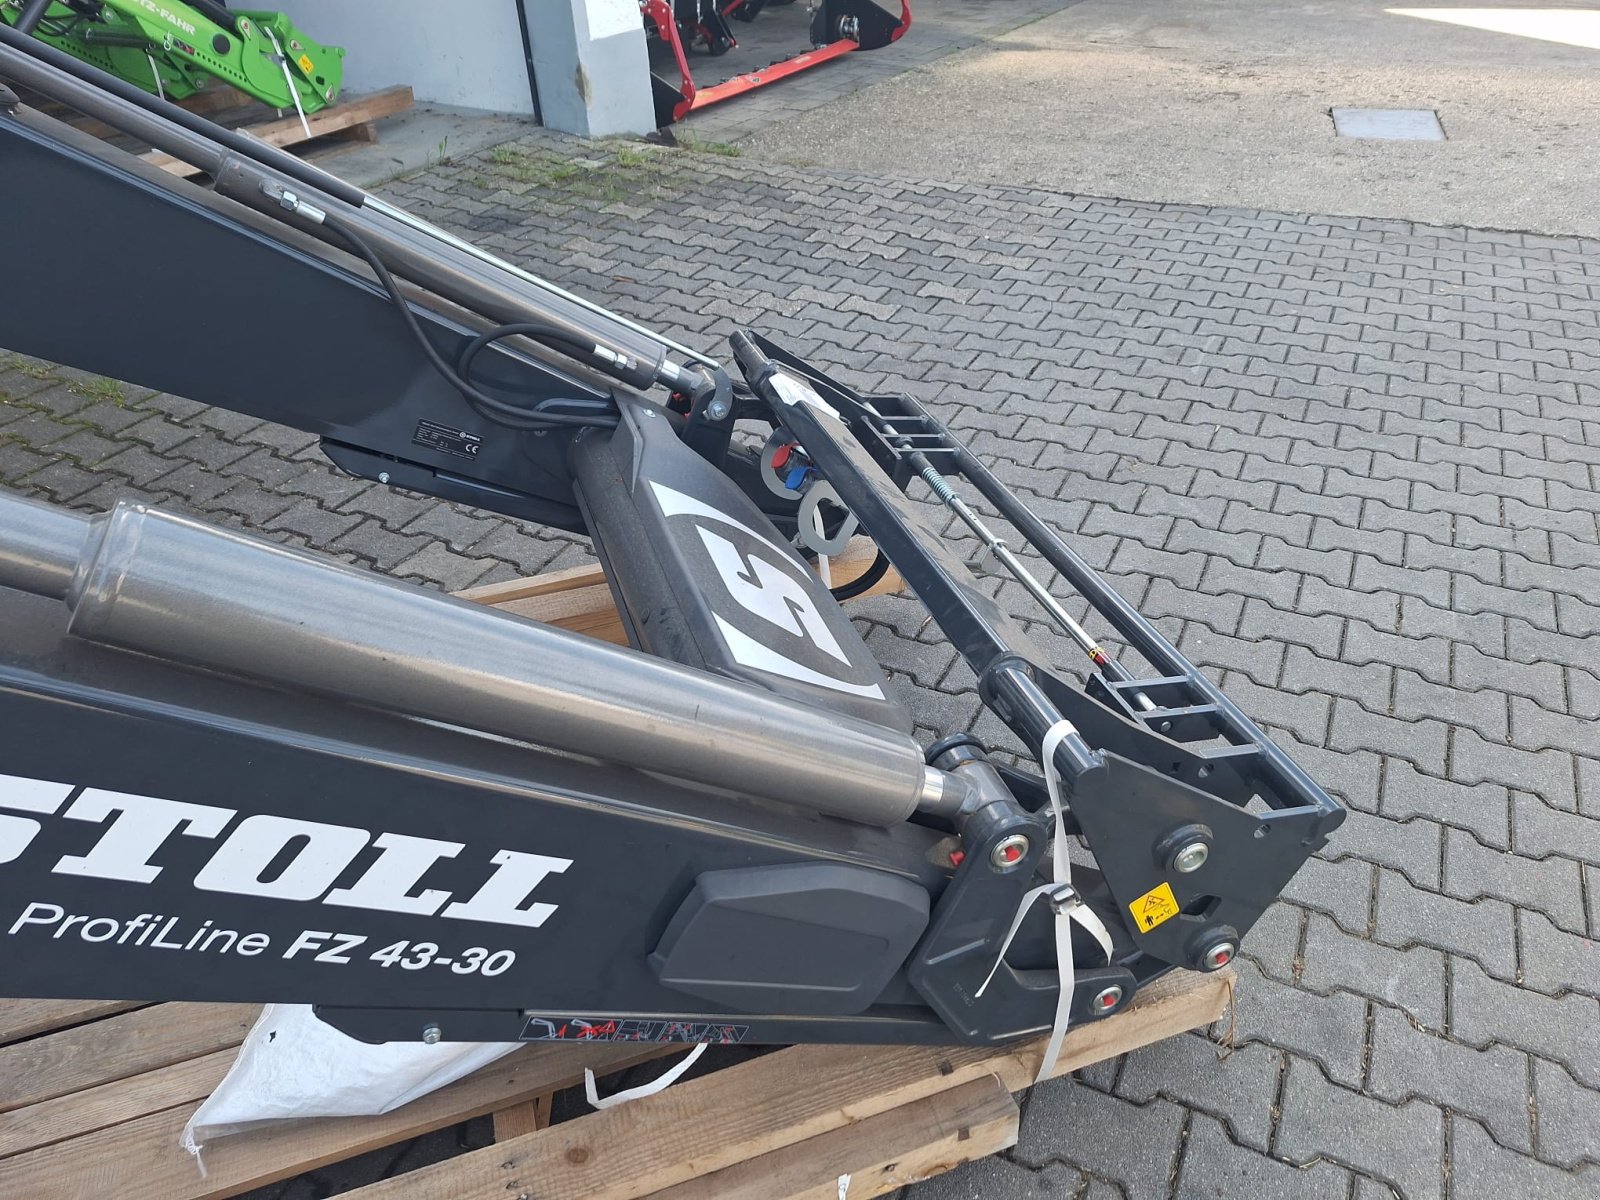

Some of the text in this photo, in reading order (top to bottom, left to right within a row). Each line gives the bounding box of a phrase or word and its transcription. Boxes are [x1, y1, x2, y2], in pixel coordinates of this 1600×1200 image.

[8, 902, 516, 977] ProfiLine FZ 43-30
